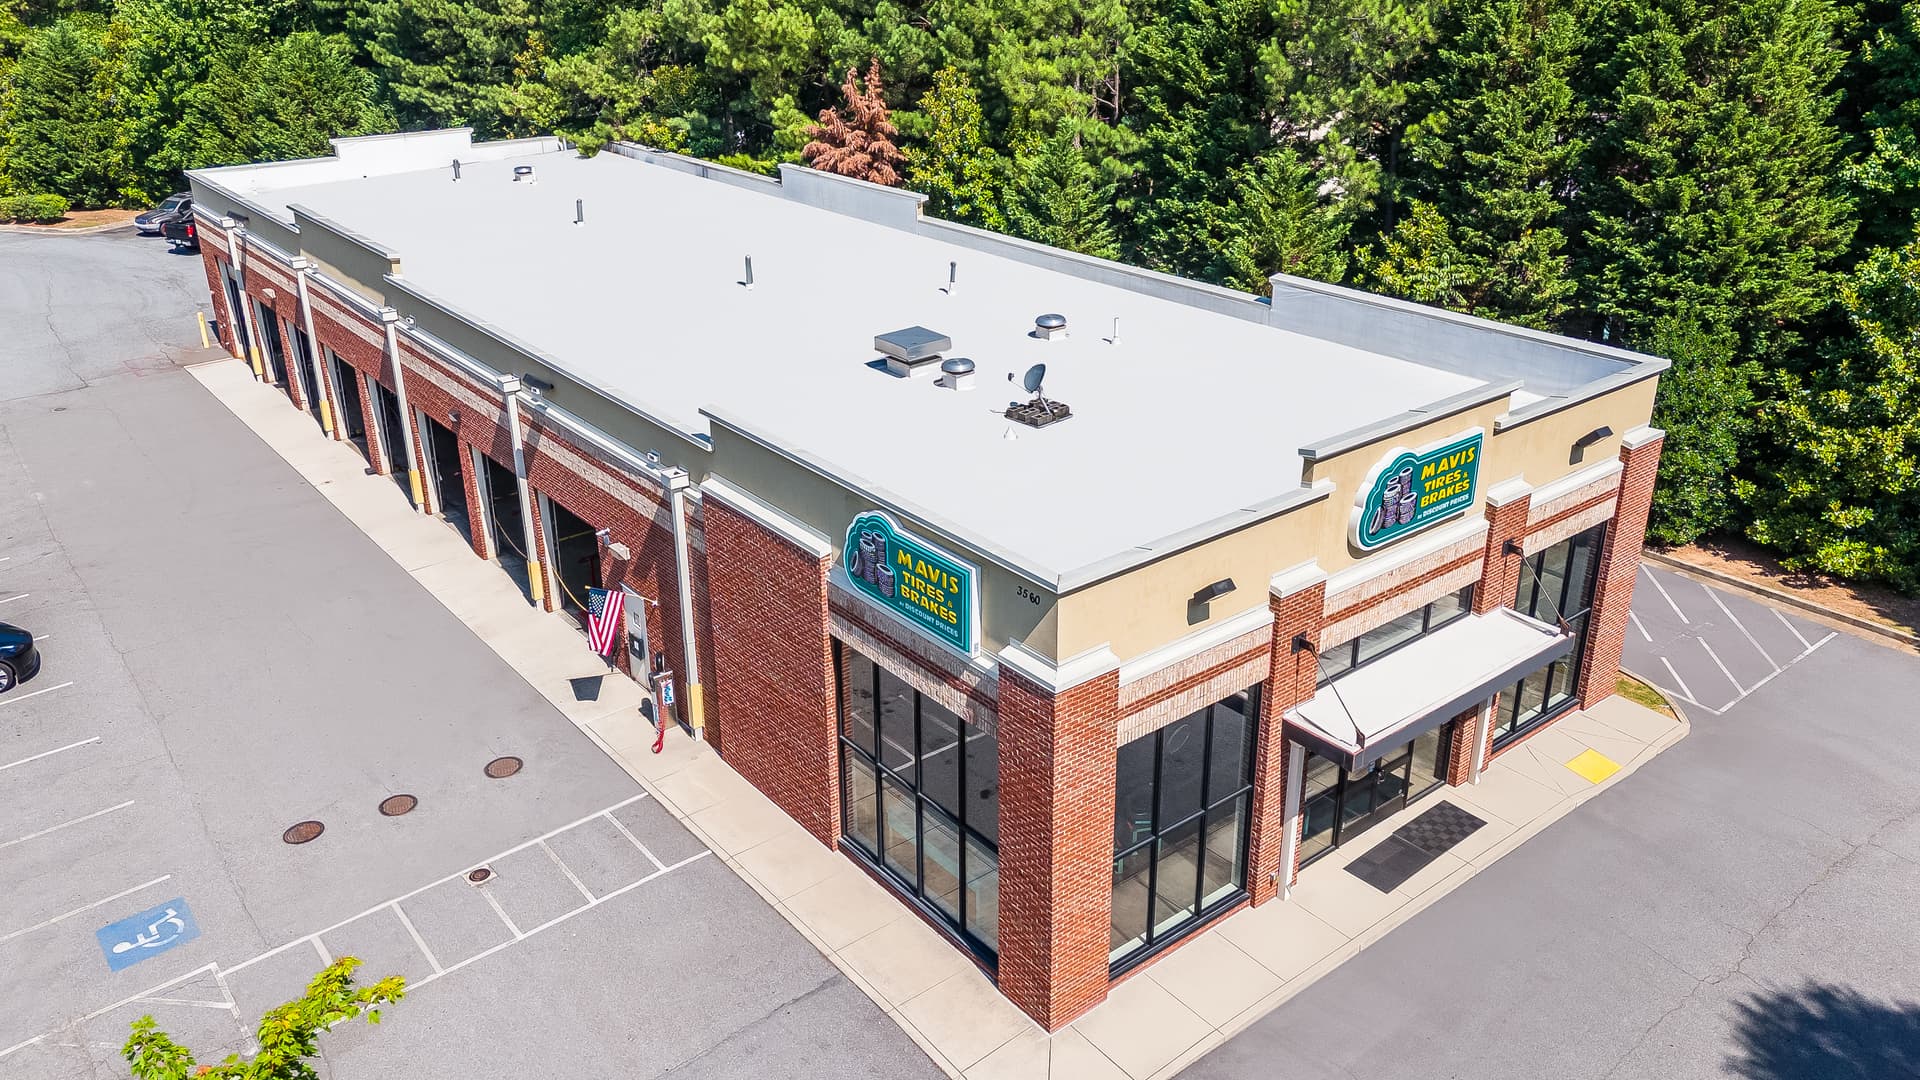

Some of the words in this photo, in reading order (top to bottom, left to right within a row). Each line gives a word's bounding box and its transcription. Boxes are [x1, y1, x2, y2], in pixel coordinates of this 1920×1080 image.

[1421, 446, 1475, 480] MAVIS
[1421, 479, 1469, 507] BRAKES
[1424, 470, 1461, 492] TIRES
[898, 549, 959, 594] MAVIS
[902, 570, 945, 602] TIRES
[901, 584, 957, 625] BRAKES
[1016, 585, 1040, 605] 3560
[905, 602, 935, 624] DISCOUNT
[935, 619, 959, 637] PRICES
